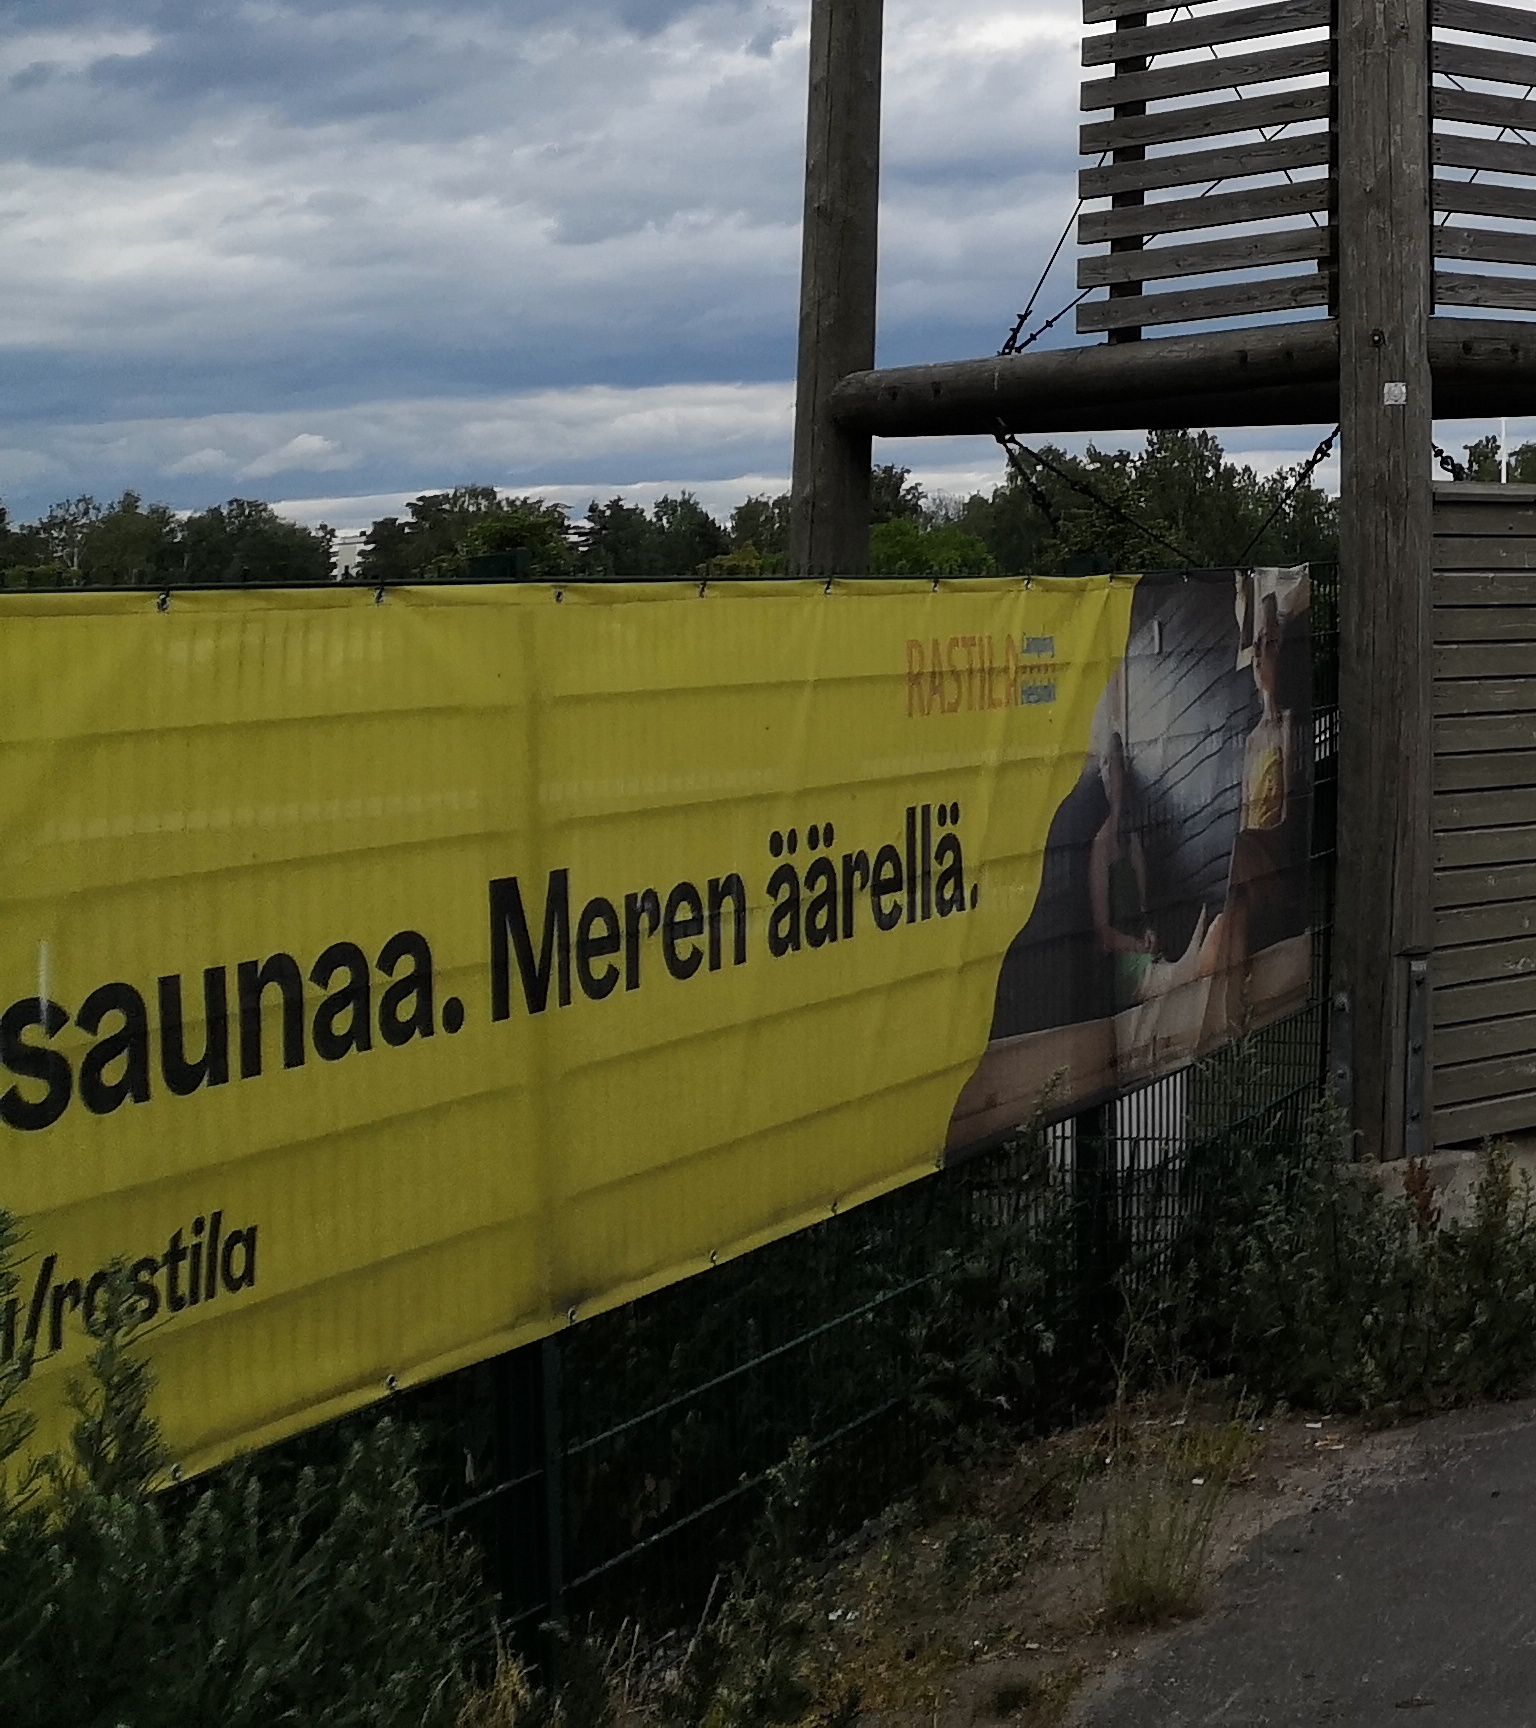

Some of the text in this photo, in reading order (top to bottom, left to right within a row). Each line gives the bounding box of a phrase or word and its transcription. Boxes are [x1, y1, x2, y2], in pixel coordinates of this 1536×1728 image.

[906, 633, 1019, 718] RASTILA
[0, 802, 980, 1133] saunaa. Meren äärellä.
